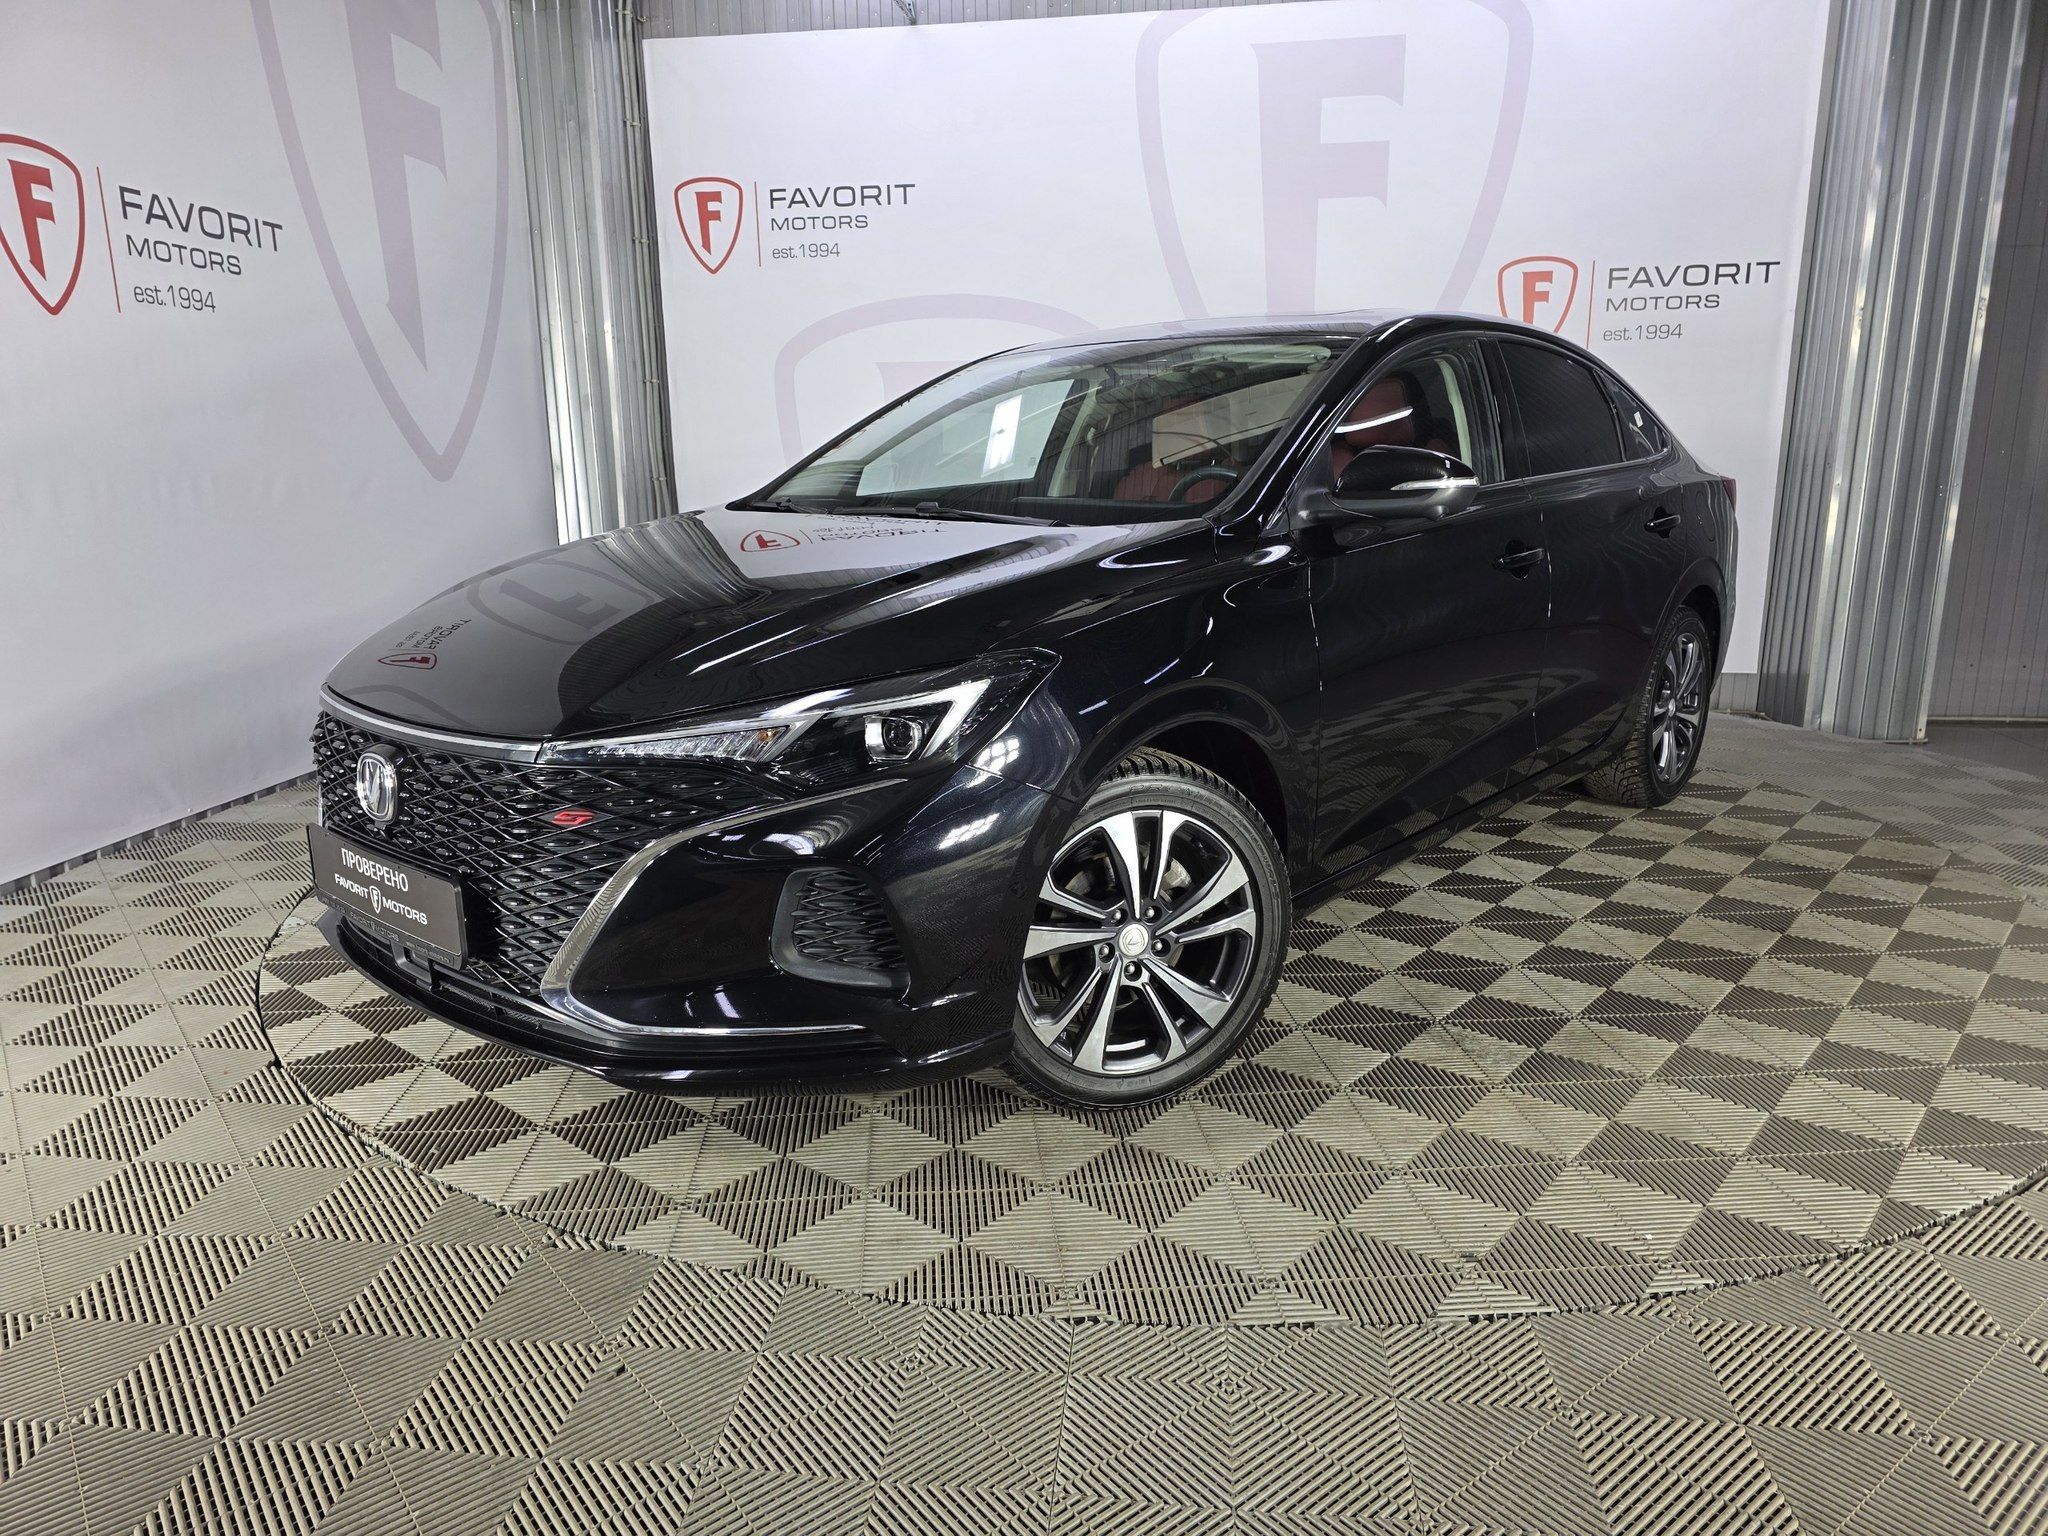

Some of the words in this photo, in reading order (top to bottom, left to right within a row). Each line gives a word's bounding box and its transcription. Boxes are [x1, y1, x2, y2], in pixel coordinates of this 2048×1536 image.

[769, 183, 915, 209] FAVORIT
[7, 159, 56, 281] F
[119, 185, 283, 251] FAVORIT
[695, 191, 722, 256] F
[771, 215, 868, 231] MOTORS
[126, 234, 242, 275] MOTORS
[772, 243, 840, 259] est.1994
[1607, 261, 1781, 289] FAVORIT
[133, 285, 216, 313] est.1994
[1522, 270, 1554, 325] F
[1605, 294, 1720, 312] MOTORS
[1603, 324, 1683, 341] est.1994
[341, 848, 409, 892] ПРОВЕРЕНО
[334, 873, 369, 899] FAVORIT
[382, 896, 428, 925] MOTORS
